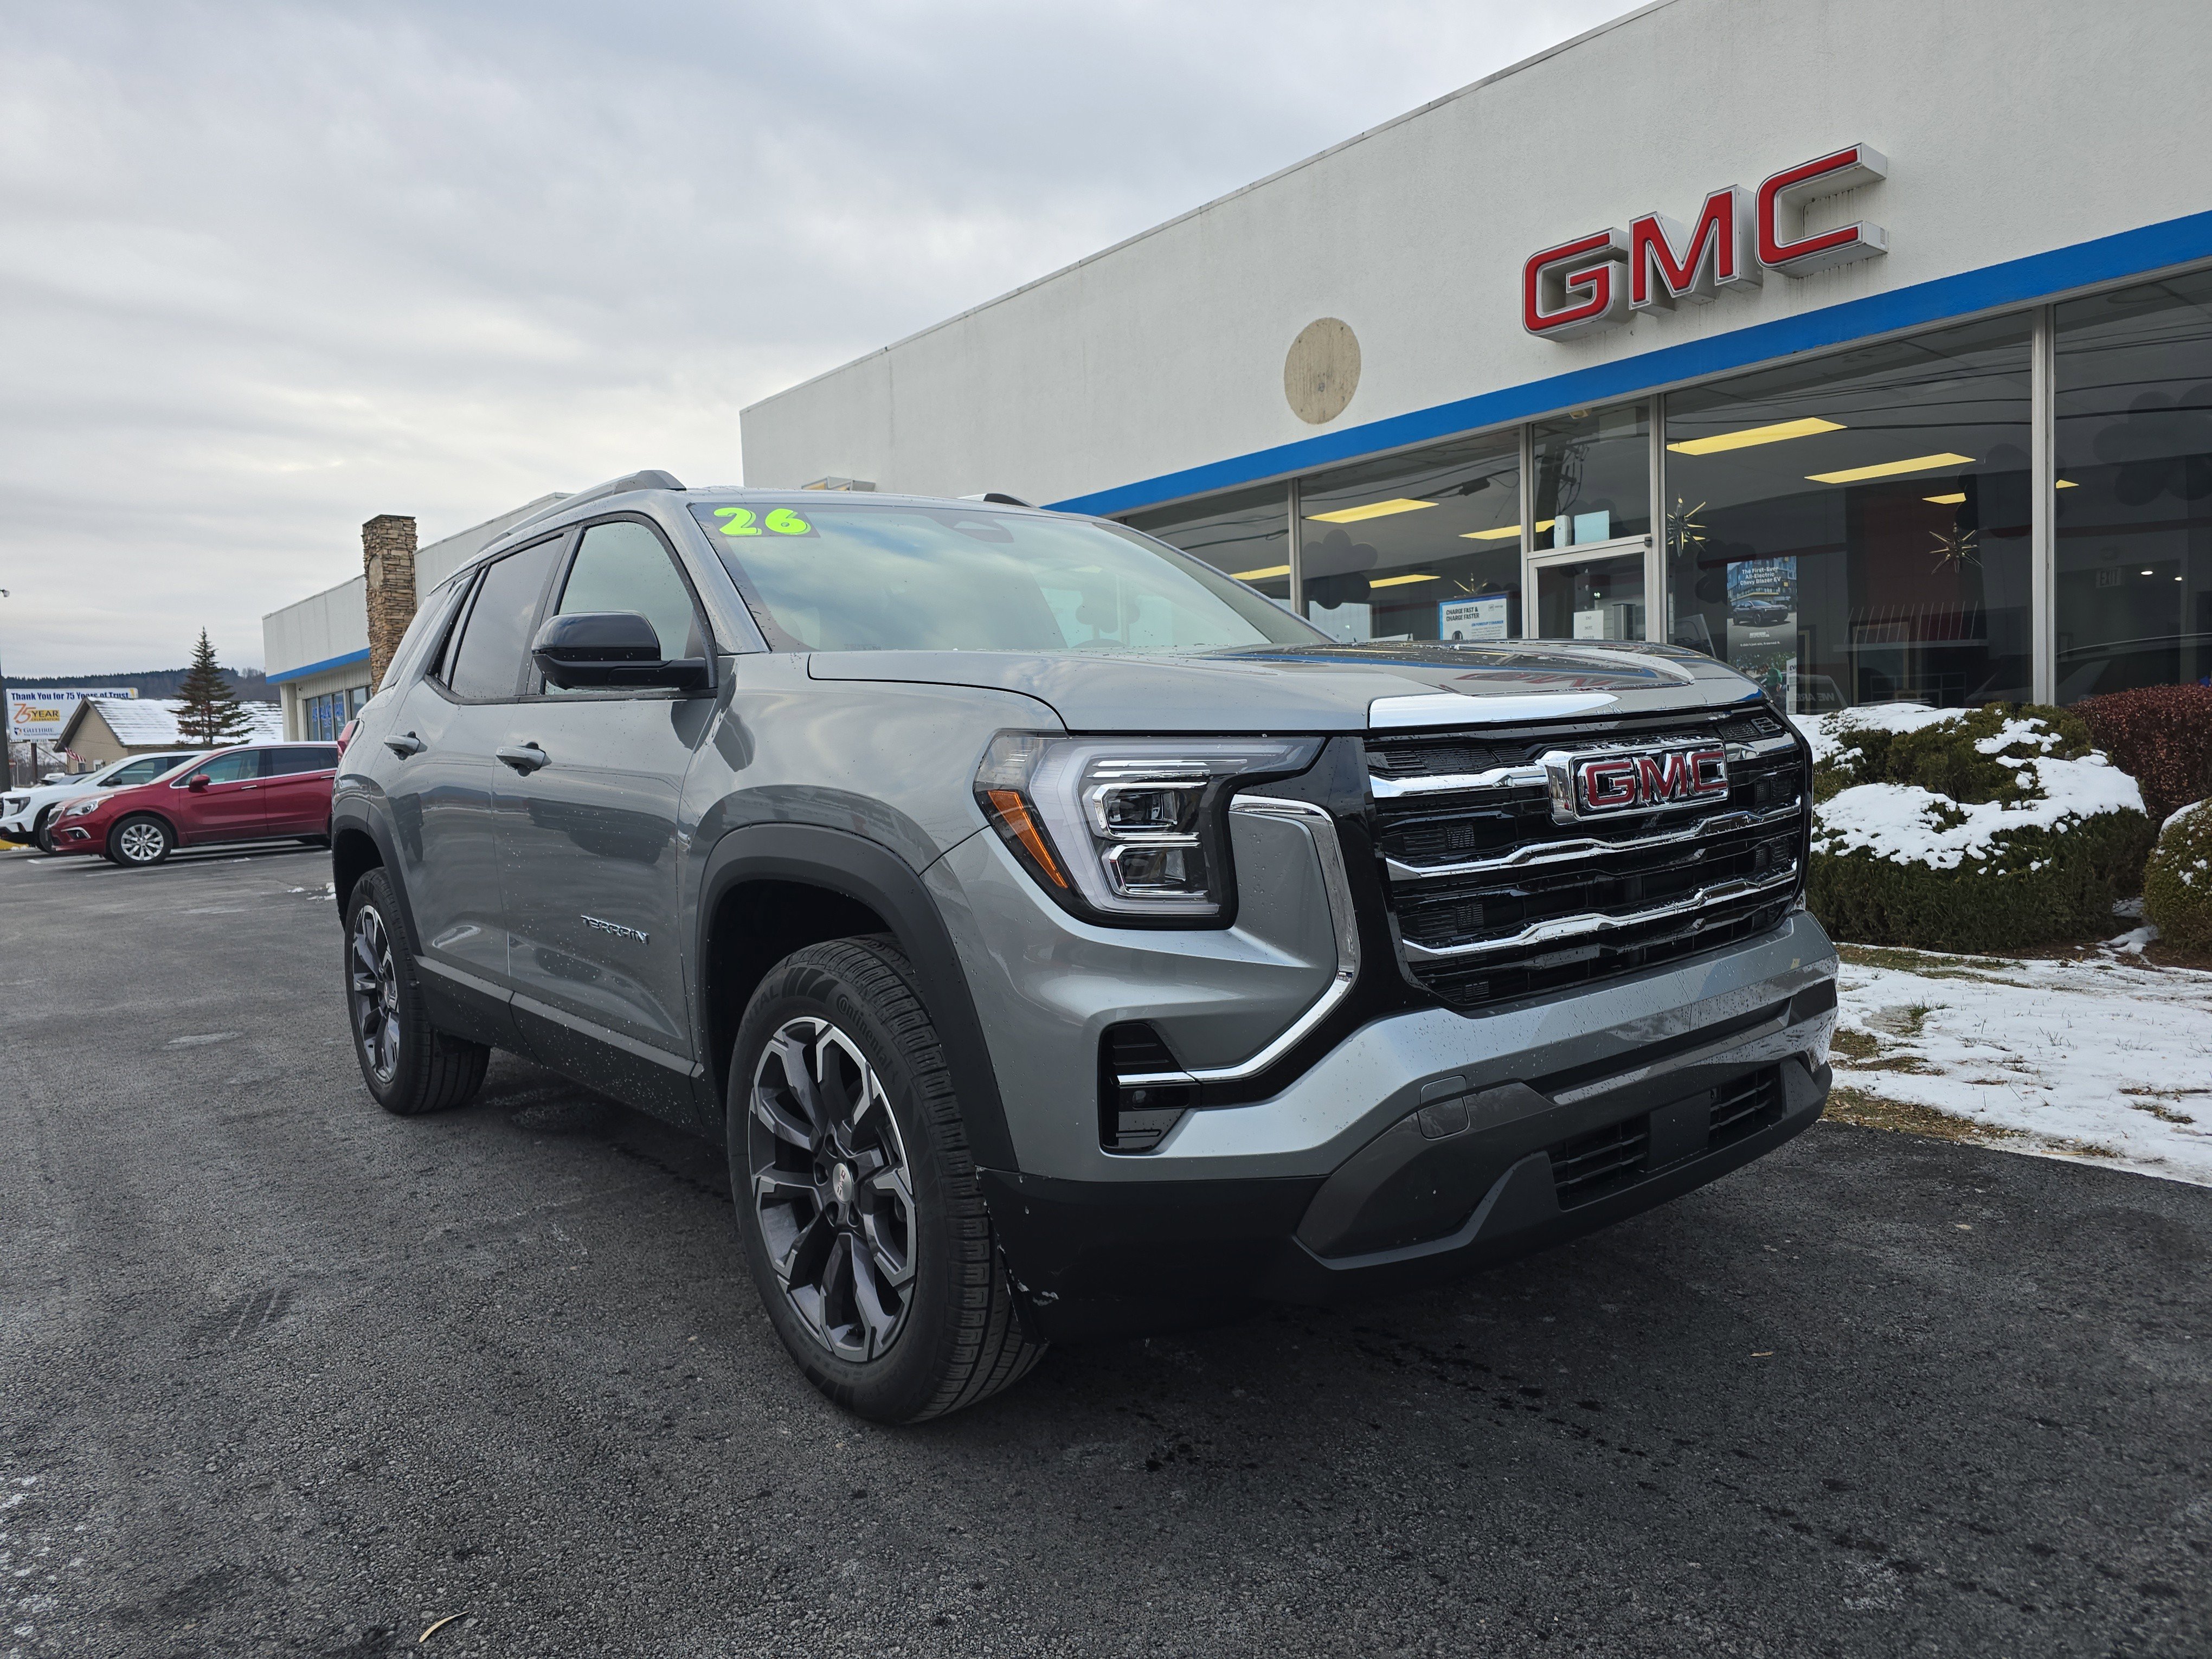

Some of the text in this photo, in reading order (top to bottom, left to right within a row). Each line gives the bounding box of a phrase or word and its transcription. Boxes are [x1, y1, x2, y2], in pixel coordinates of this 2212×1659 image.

[1522, 142, 1865, 336] GMC
[713, 507, 811, 536] 26
[11, 692, 36, 700] Thank
[53, 692, 65, 700] for
[66, 692, 75, 700] 75
[1580, 750, 1729, 809] GMC
[580, 914, 650, 946] TERRAIN
[837, 993, 894, 1072] Continental
